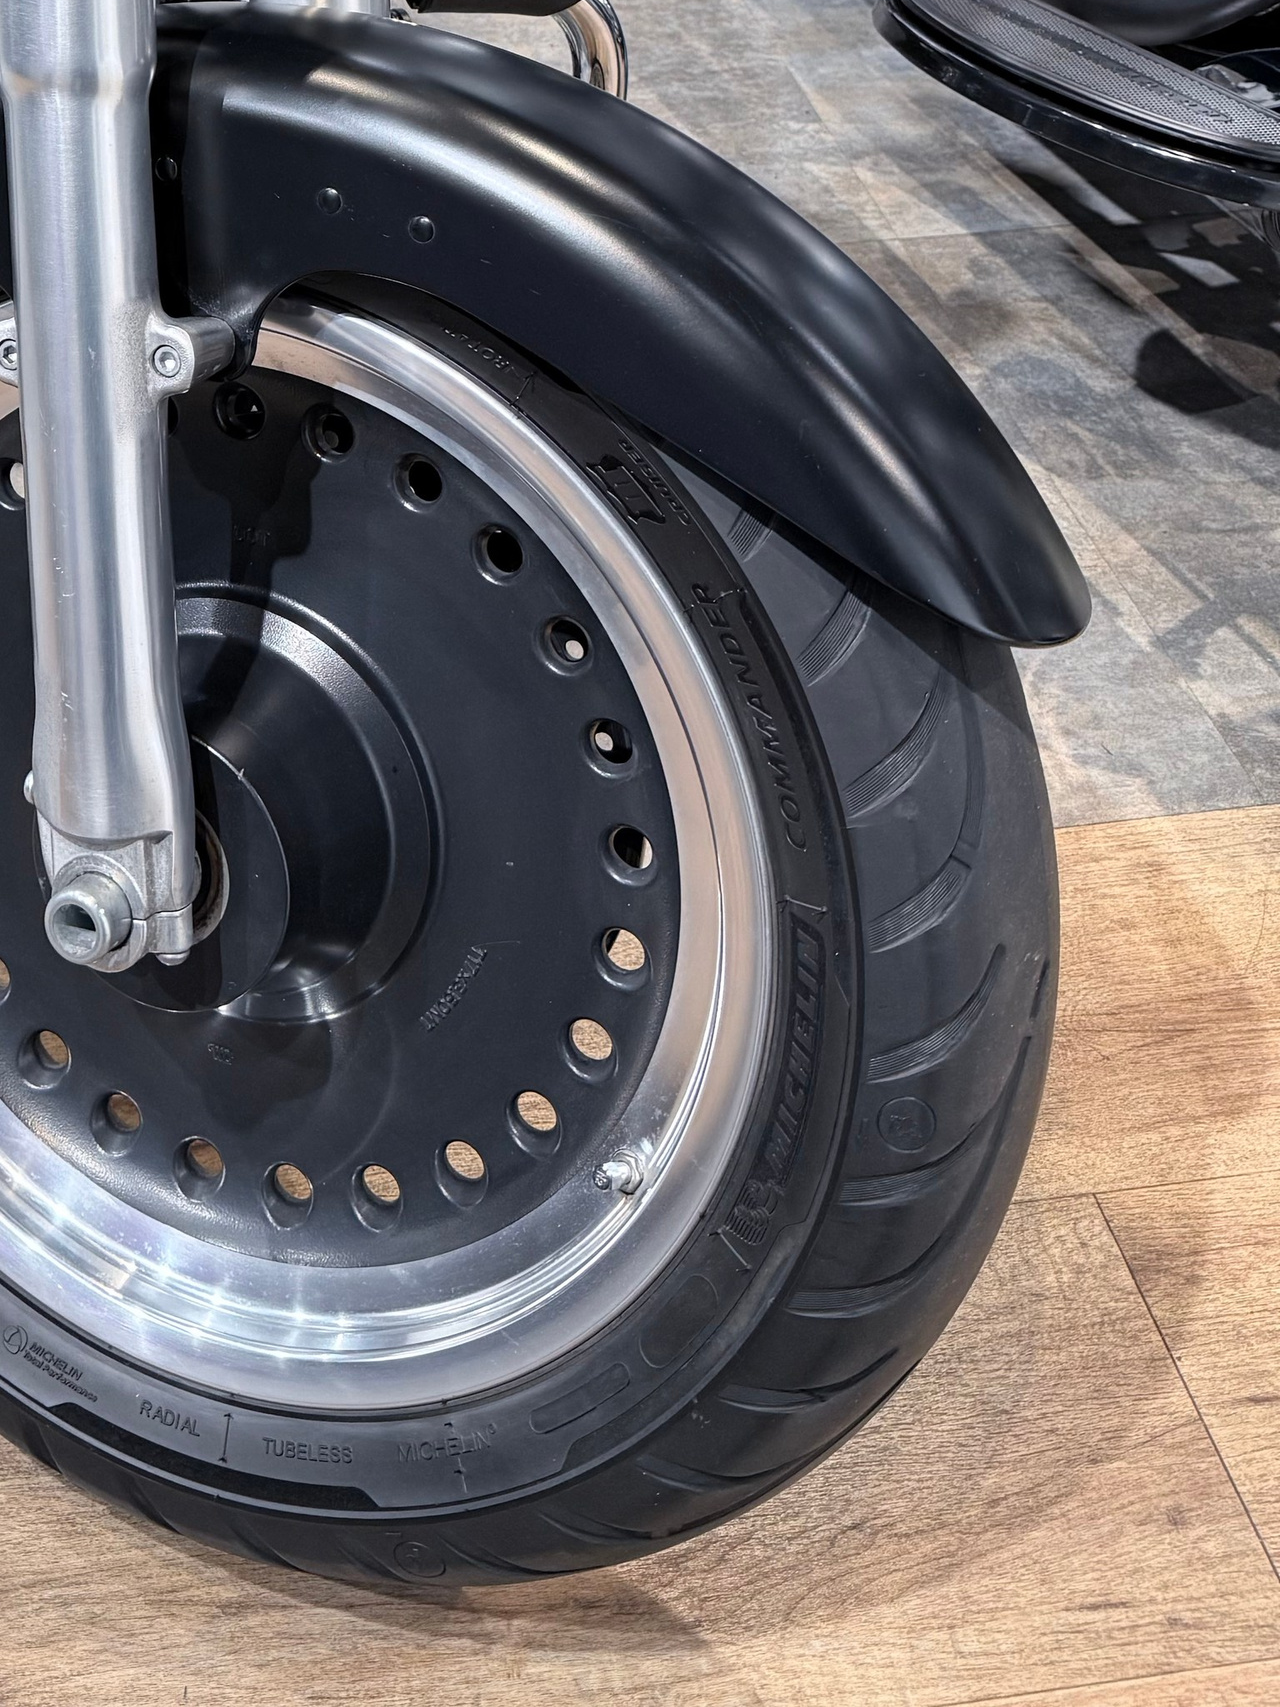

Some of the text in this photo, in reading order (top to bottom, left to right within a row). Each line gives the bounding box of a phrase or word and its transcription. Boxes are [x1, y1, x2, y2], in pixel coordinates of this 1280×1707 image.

[688, 580, 806, 851] COMMANDER
[763, 927, 819, 1174] MICHELIN
[28, 1340, 84, 1381] MICHELIN
[139, 1400, 490, 1465] RADIAL TUBELESS MICHELIN
